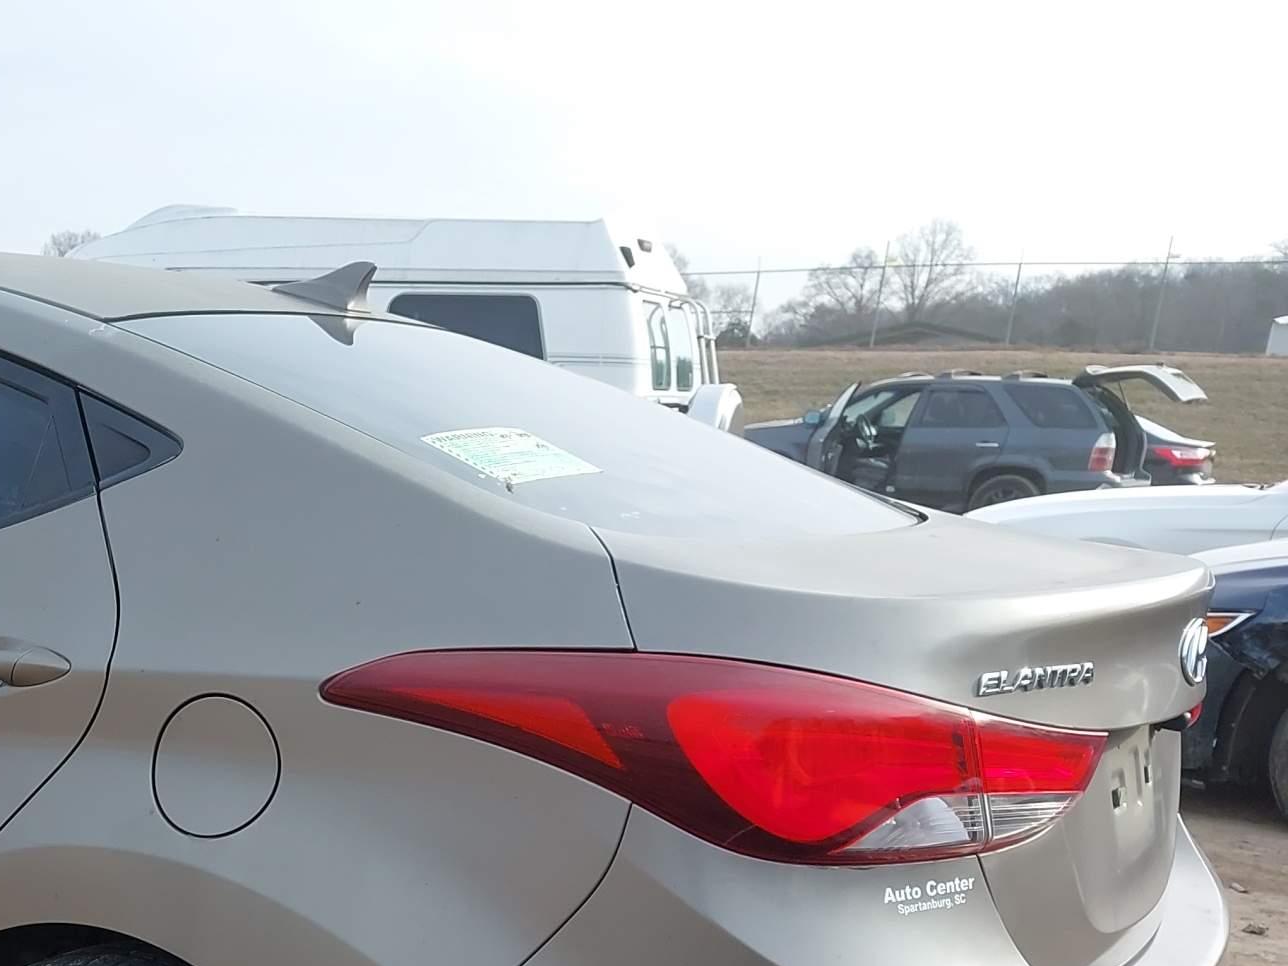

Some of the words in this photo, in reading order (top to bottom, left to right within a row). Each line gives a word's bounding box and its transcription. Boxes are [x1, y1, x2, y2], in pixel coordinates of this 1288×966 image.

[976, 661, 1094, 696] ELANTRA
[884, 885, 921, 904] Auto
[926, 877, 975, 897] Center
[897, 897, 953, 916] Spartanburg,
[954, 893, 967, 905] SC
